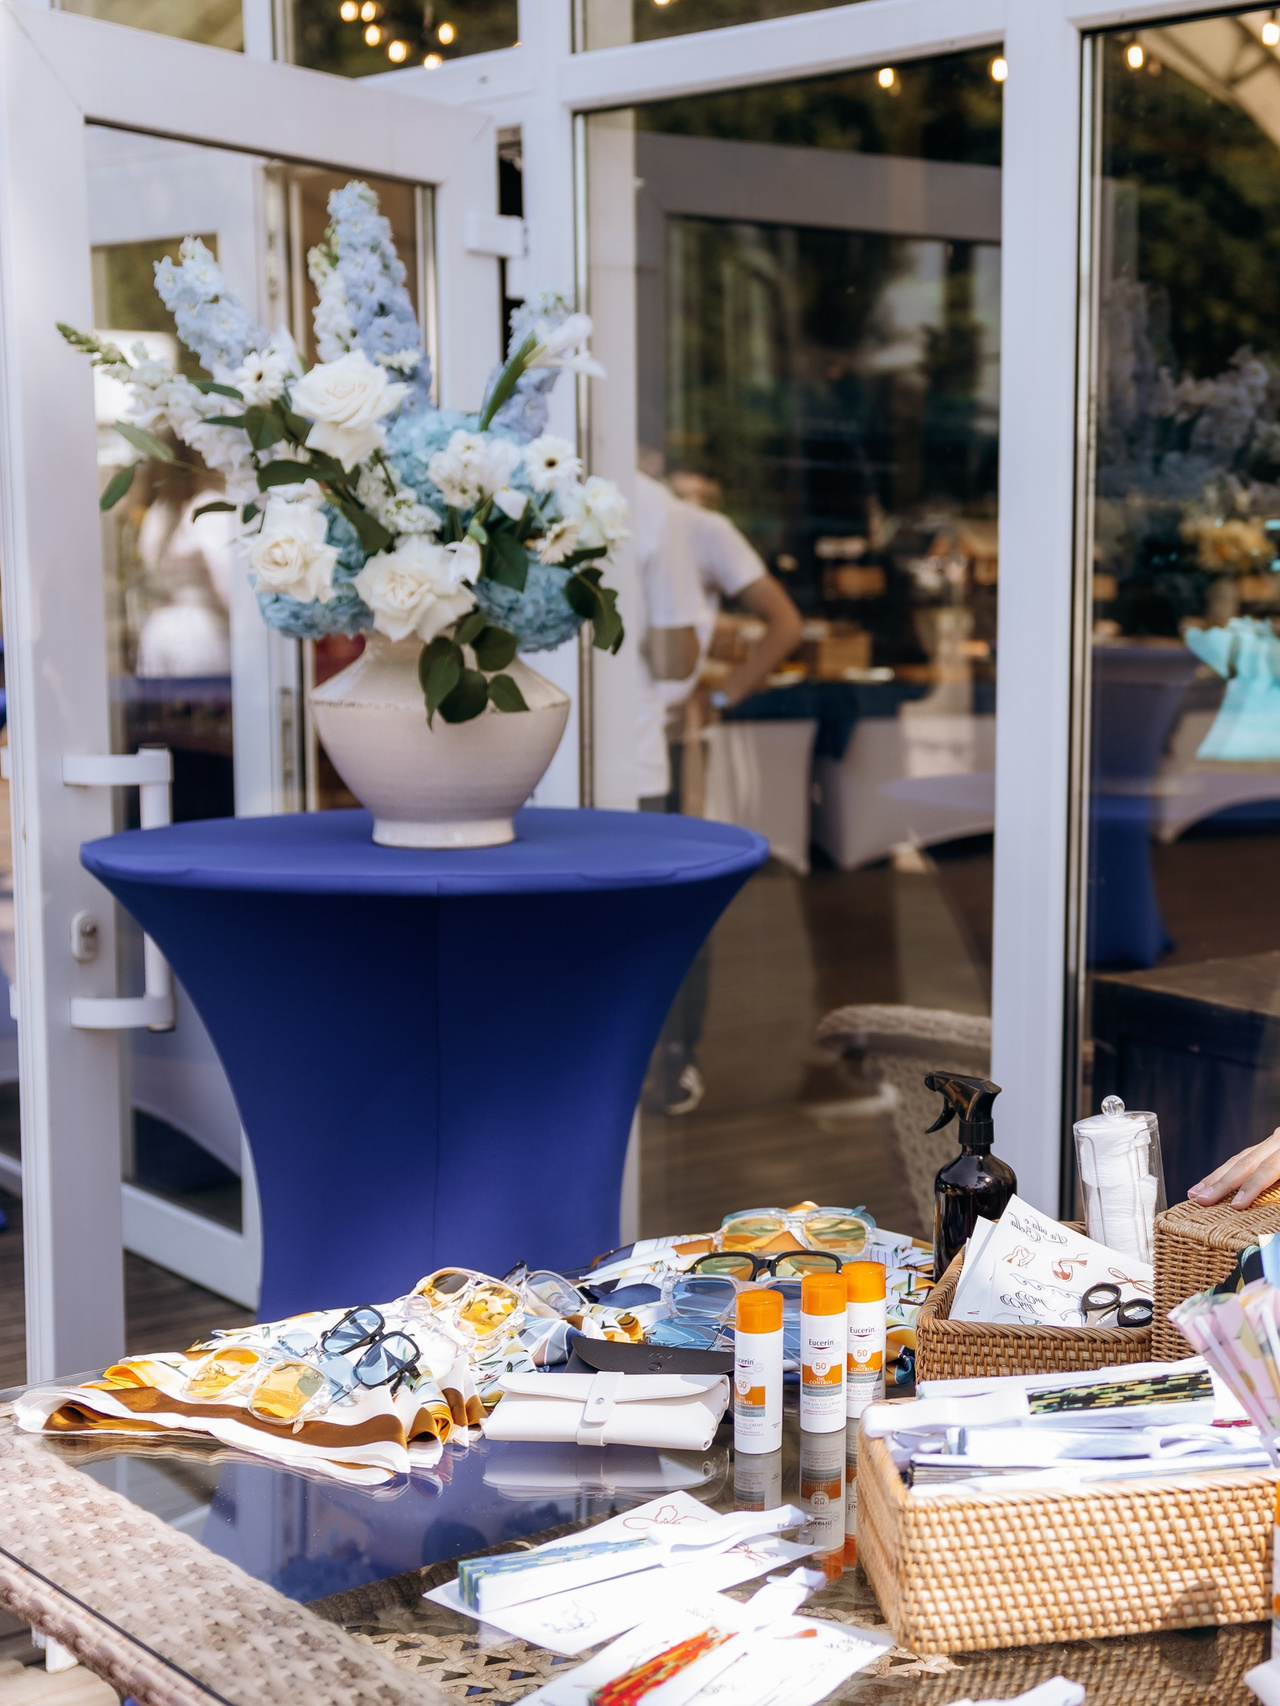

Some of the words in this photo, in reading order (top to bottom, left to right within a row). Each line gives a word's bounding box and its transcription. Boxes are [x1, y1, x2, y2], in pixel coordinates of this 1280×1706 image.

[849, 1326, 875, 1334] Eucerin
[808, 1338, 834, 1346] Eucerin
[735, 1357, 754, 1365] ucerin
